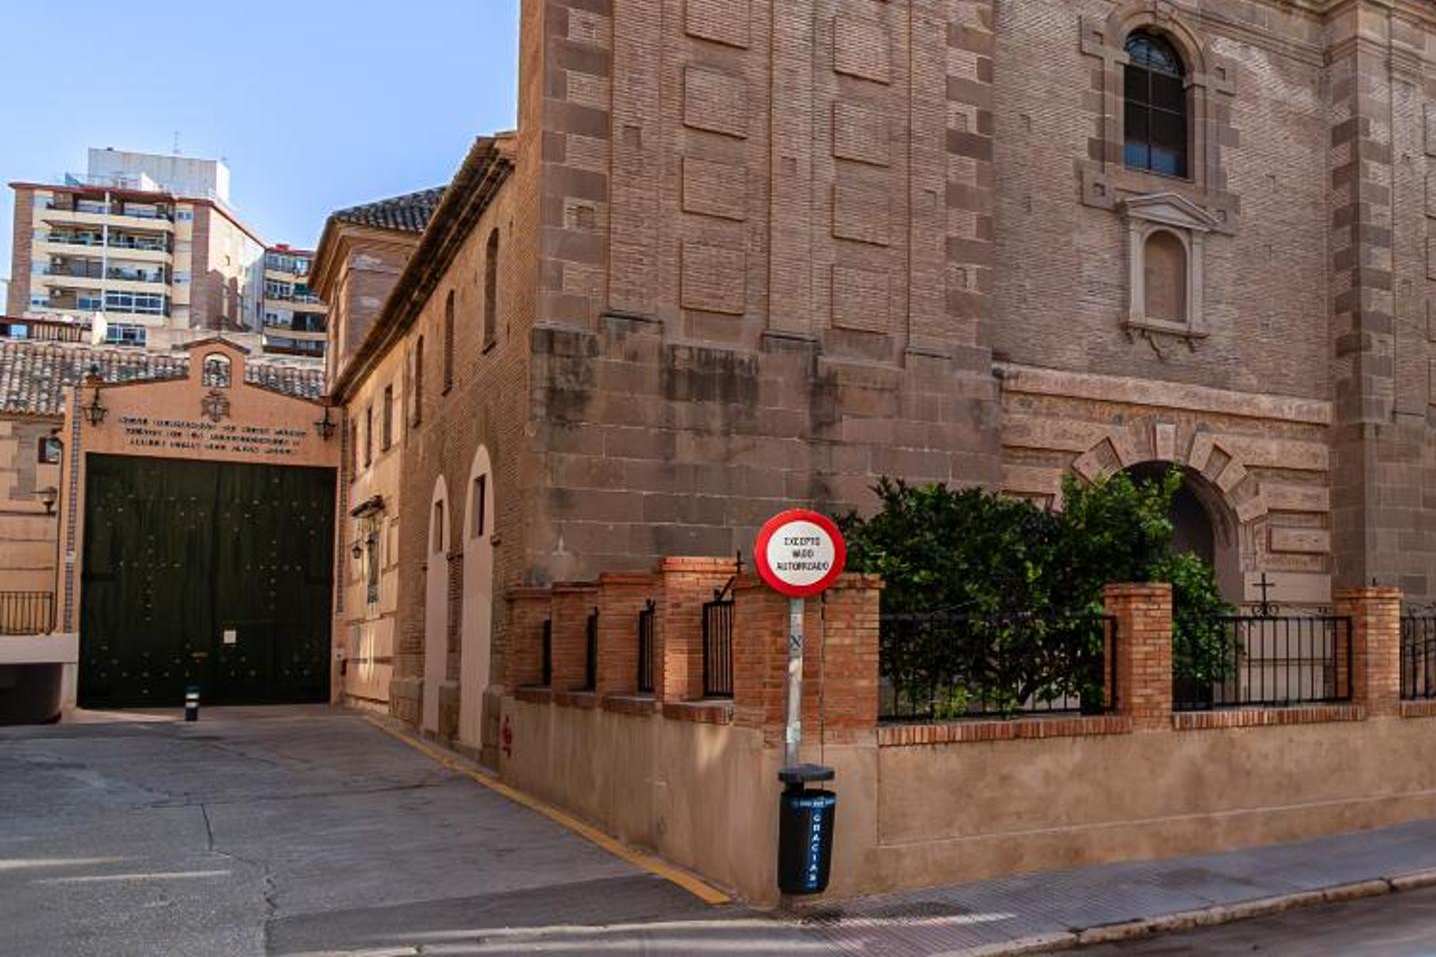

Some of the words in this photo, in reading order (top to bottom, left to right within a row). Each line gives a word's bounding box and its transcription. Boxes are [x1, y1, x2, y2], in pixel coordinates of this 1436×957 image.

[784, 537, 821, 547] EXCEPTO
[776, 561, 830, 571] AUTORIZADO
[809, 813, 821, 881] GRACIAS
